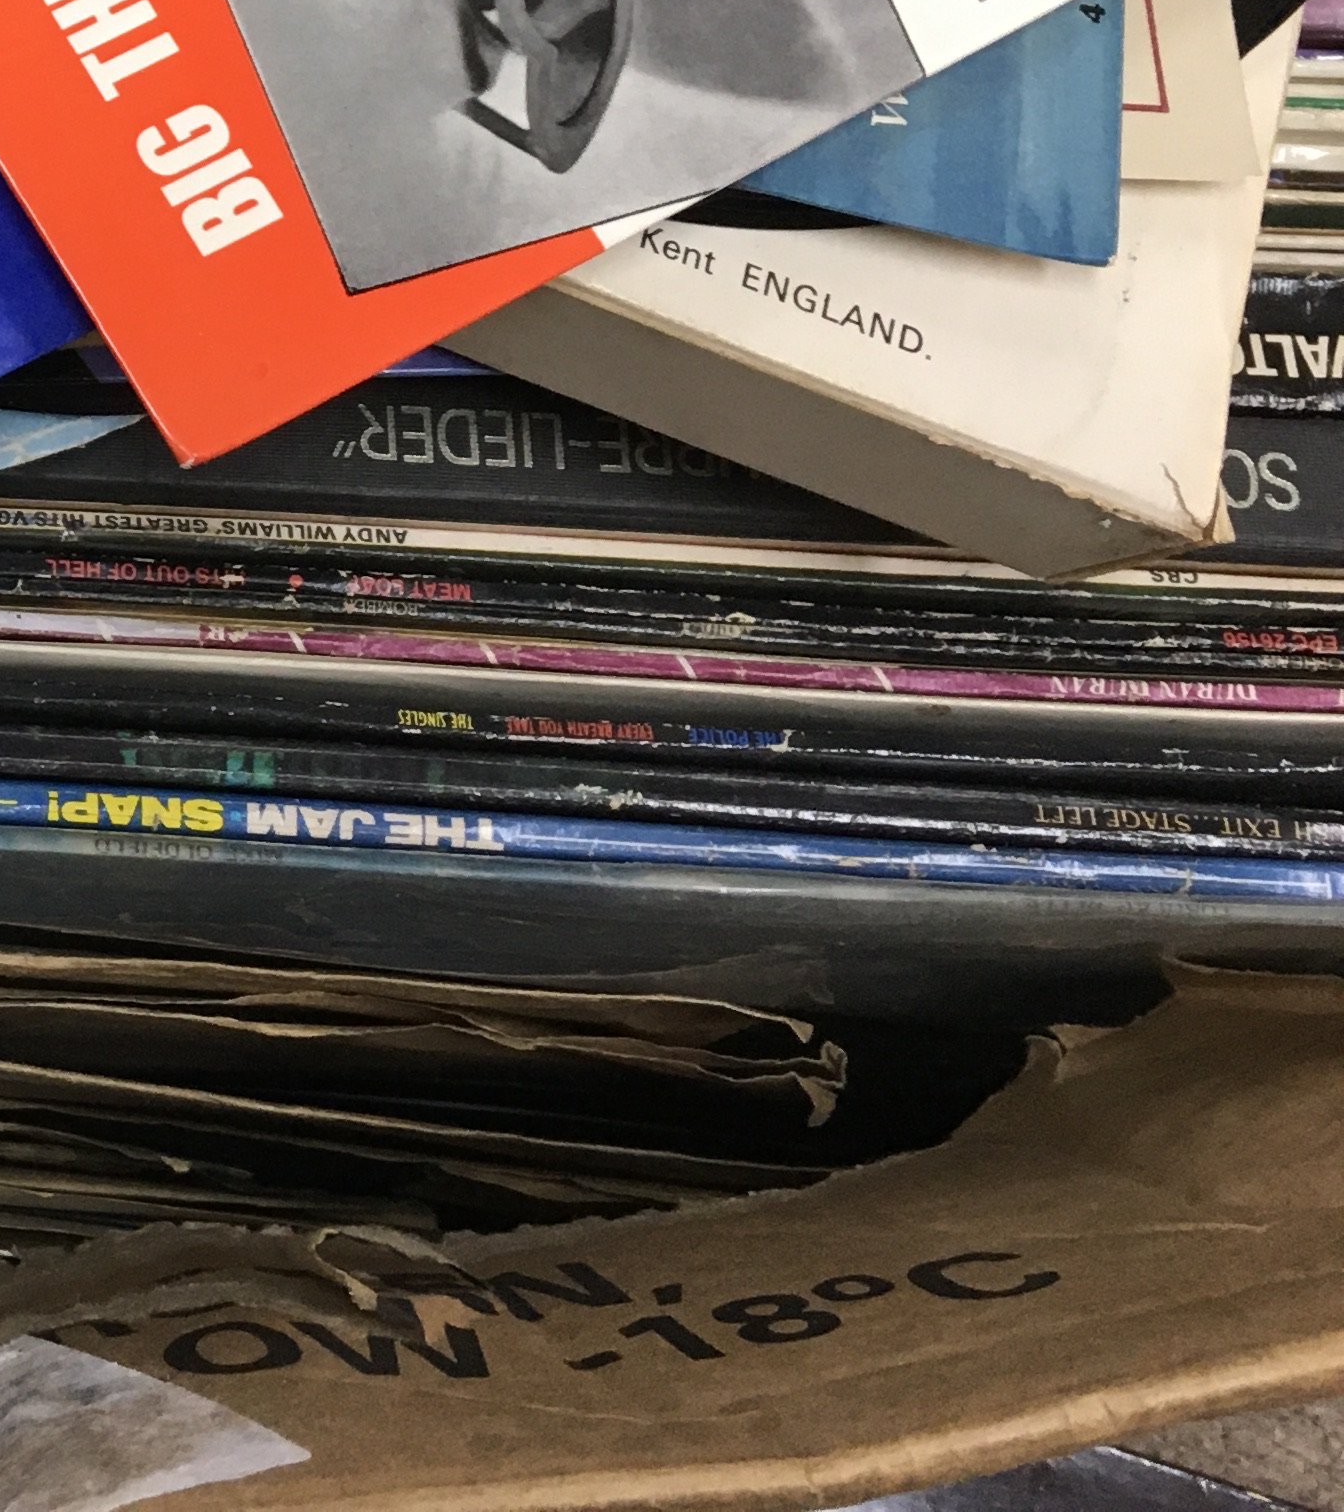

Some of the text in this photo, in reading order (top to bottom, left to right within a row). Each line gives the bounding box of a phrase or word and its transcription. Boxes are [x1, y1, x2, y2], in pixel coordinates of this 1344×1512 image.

[136, 104, 284, 257] BIG
[640, 226, 934, 361] Kent ENGLAND.
[88, 515, 408, 545] ANDY WILLIAMS' GREATEST
[46, 558, 138, 581] OF HELL
[1048, 675, 1259, 702] DURAN DURAN
[396, 708, 474, 732] THE SINGLES
[505, 715, 654, 742] EVERY BREATH YOU TAKE
[47, 790, 504, 852] THE JAM SNAP!
[1033, 803, 1097, 827] LEFT
